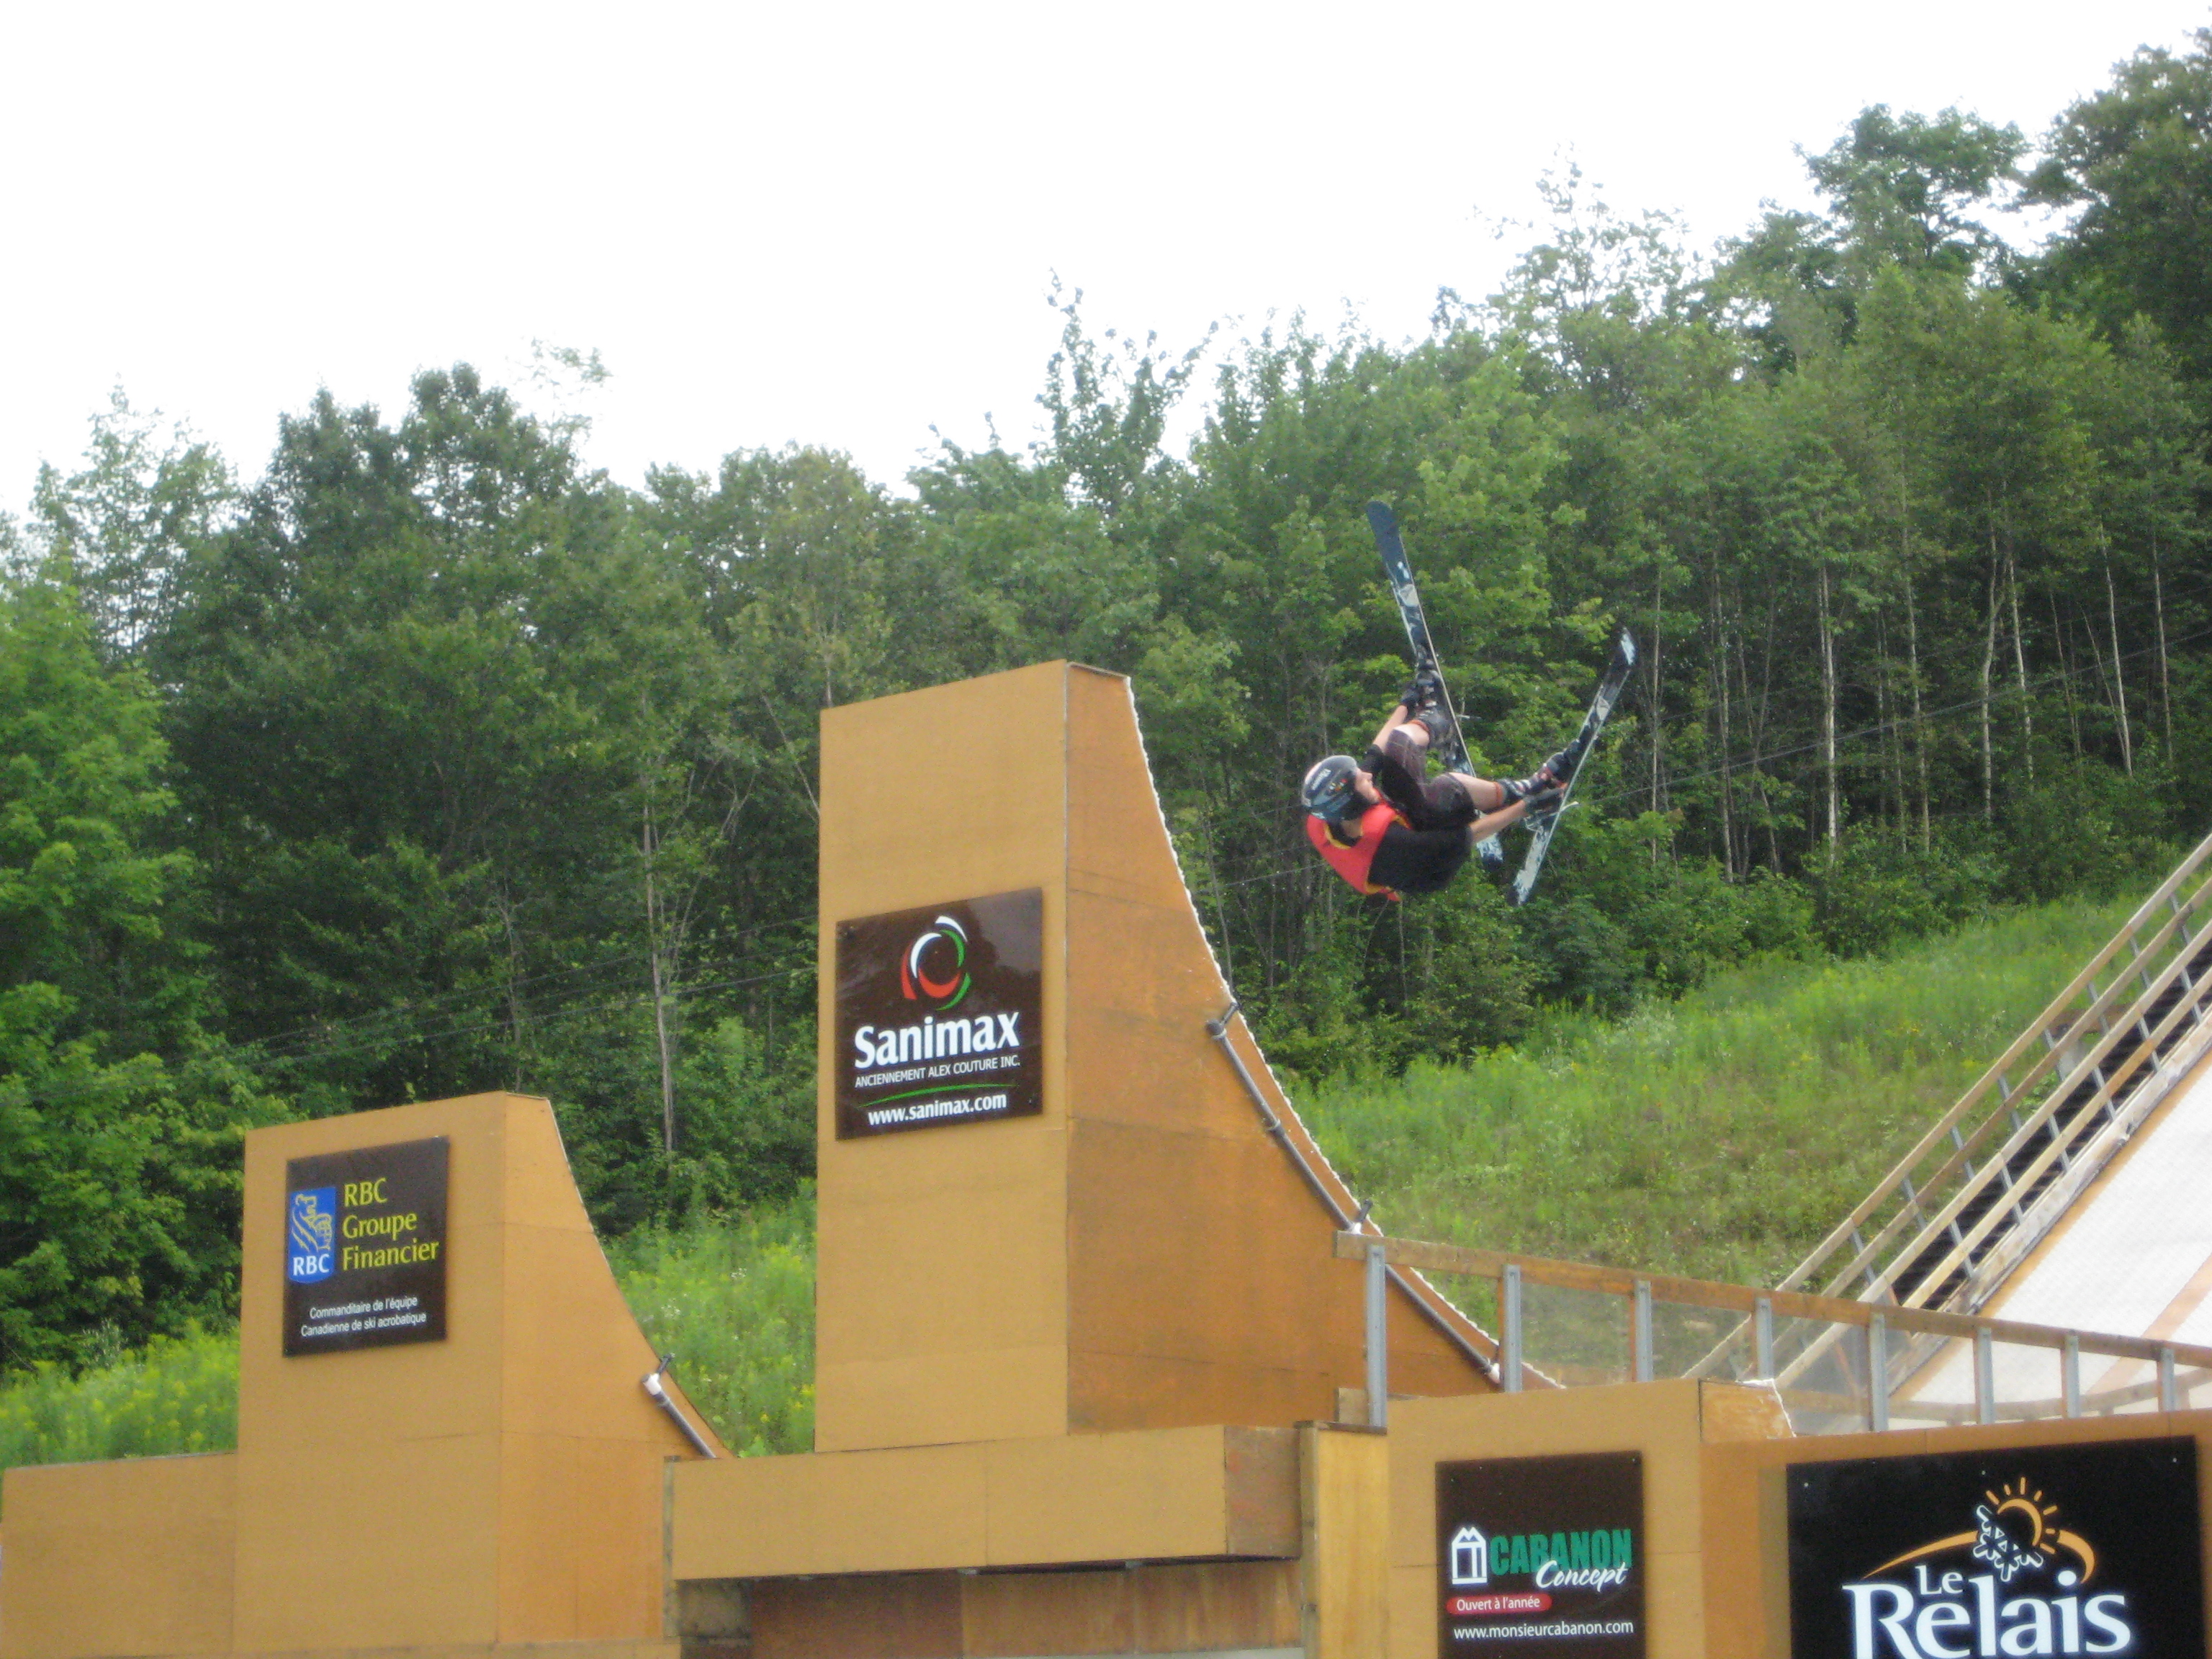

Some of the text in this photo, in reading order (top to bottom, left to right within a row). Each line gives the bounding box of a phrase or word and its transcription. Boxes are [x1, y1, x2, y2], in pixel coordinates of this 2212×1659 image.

[855, 1012, 1020, 1069] Sanimax
[855, 1055, 1020, 1088] ANCIENNEMENT ALEX COUTURE INC.
[868, 1093, 1007, 1126] www.sanimax.com
[344, 1177, 387, 1207] RBC
[342, 1213, 418, 1241] Groupe
[293, 1254, 330, 1276] RBC
[342, 1238, 439, 1271] Financier
[310, 1295, 418, 1319] Commanditaire de l'équipe
[301, 1312, 427, 1336] Canadienne de ski acrobatique
[1489, 1528, 1632, 1575] CABANON
[1535, 1560, 1628, 1593] Concept
[1915, 1564, 1964, 1596] Le
[1456, 1596, 1540, 1611] Ouvert à l'année
[1842, 1570, 2132, 1659] Relais
[1454, 1620, 1634, 1639] www.monsieurcabanon.com
